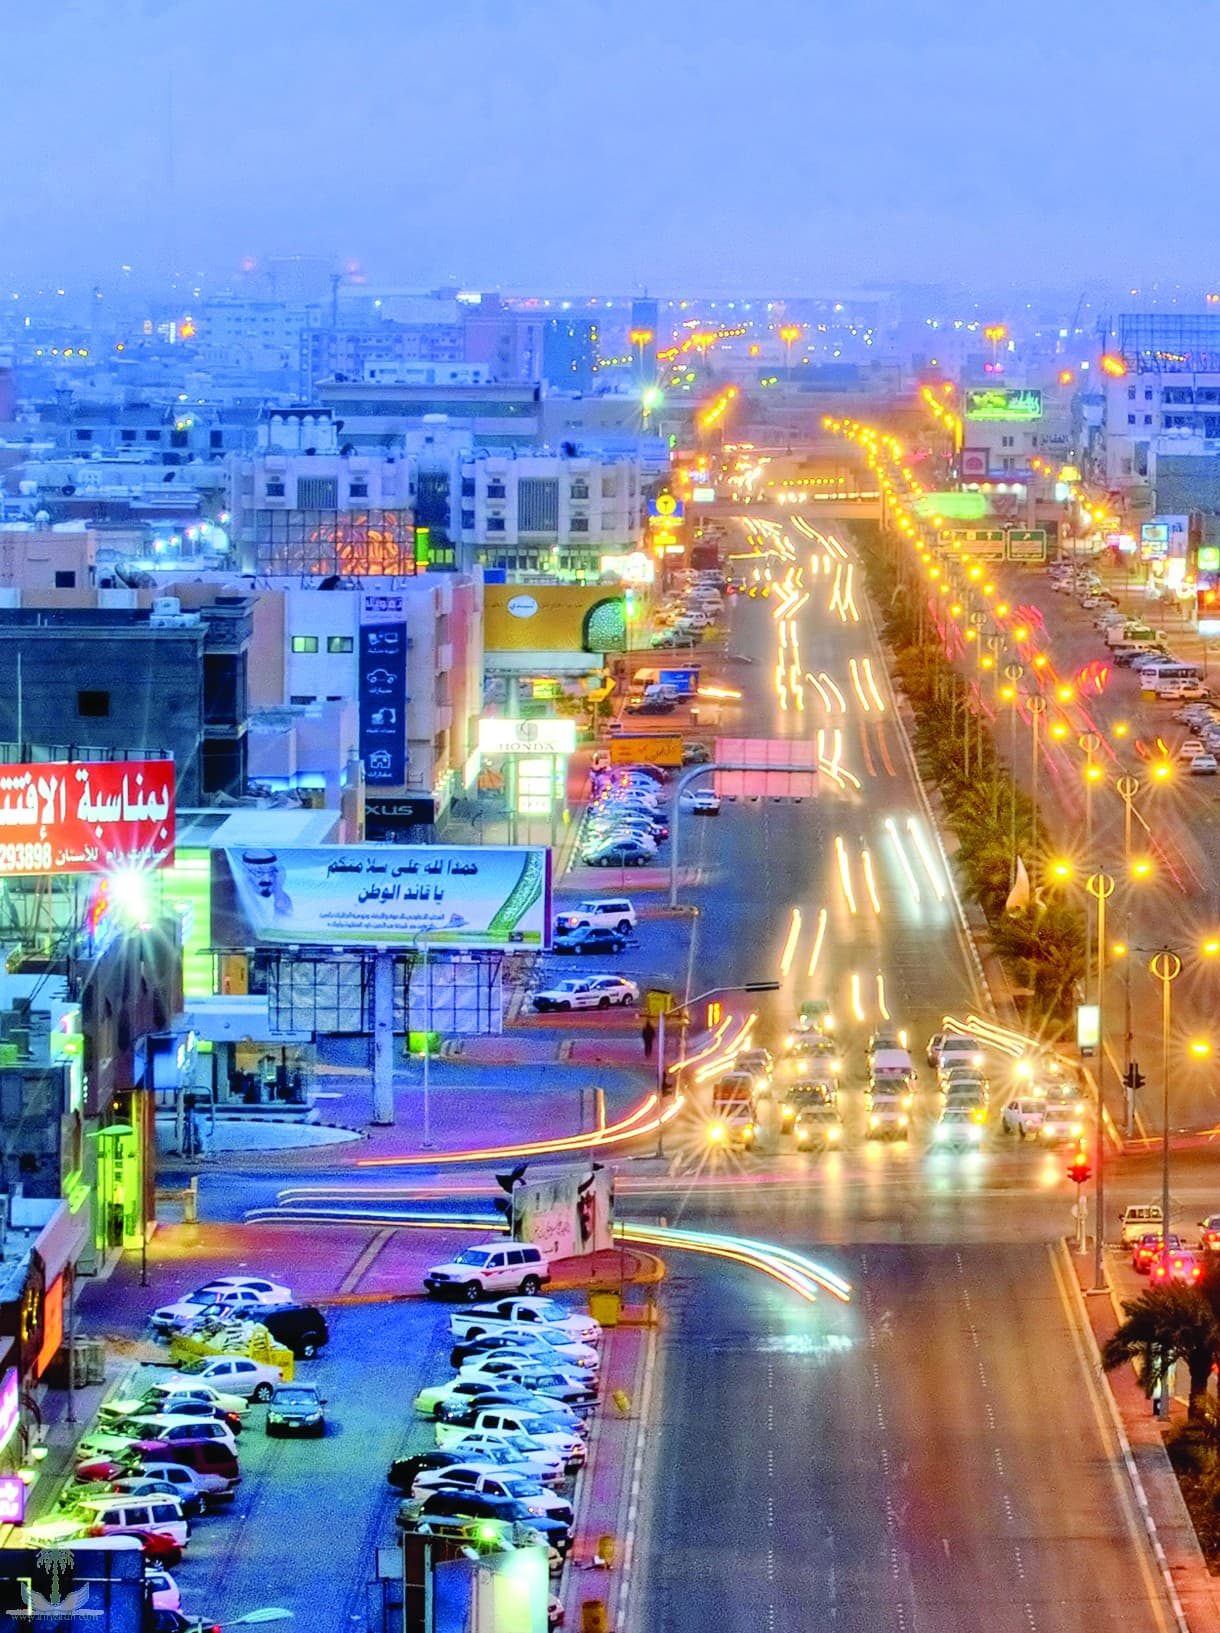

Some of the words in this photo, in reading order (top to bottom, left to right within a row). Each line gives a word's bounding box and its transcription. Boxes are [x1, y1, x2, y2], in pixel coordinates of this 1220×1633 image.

[499, 743, 554, 751] HONDA
[75, 768, 170, 840] بمناسبة
[391, 858, 420, 878] على
[357, 882, 401, 904] الوطن
